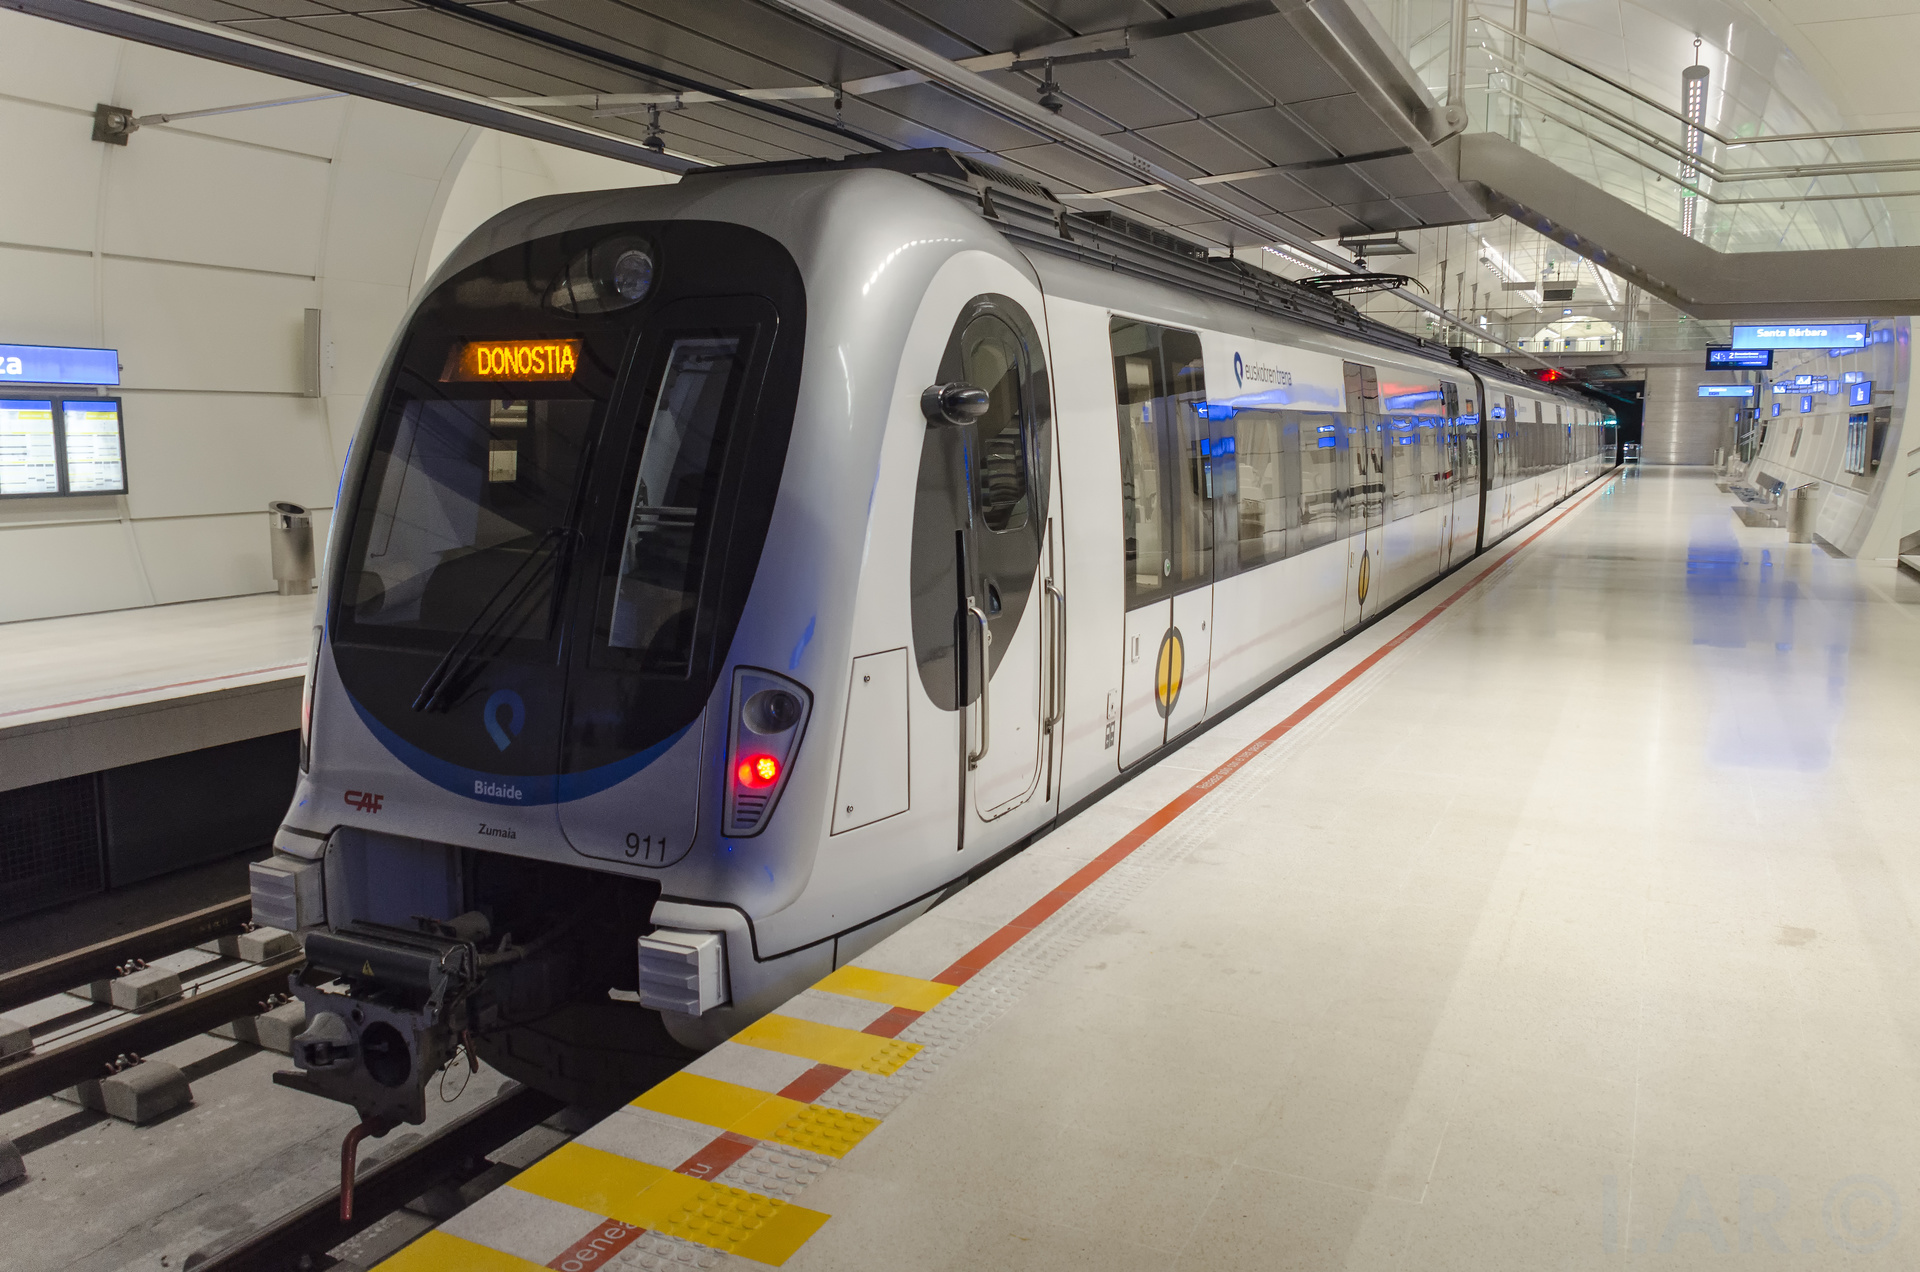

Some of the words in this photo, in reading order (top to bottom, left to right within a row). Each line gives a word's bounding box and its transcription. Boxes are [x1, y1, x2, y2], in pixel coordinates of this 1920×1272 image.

[1756, 328, 1787, 338] Santa
[1788, 327, 1828, 337] Bárbara
[477, 345, 576, 375] DONOSTIA
[473, 780, 523, 800] Bidaide
[343, 789, 385, 814] CAF
[477, 823, 517, 841] Zumaia
[624, 832, 667, 863] 911
